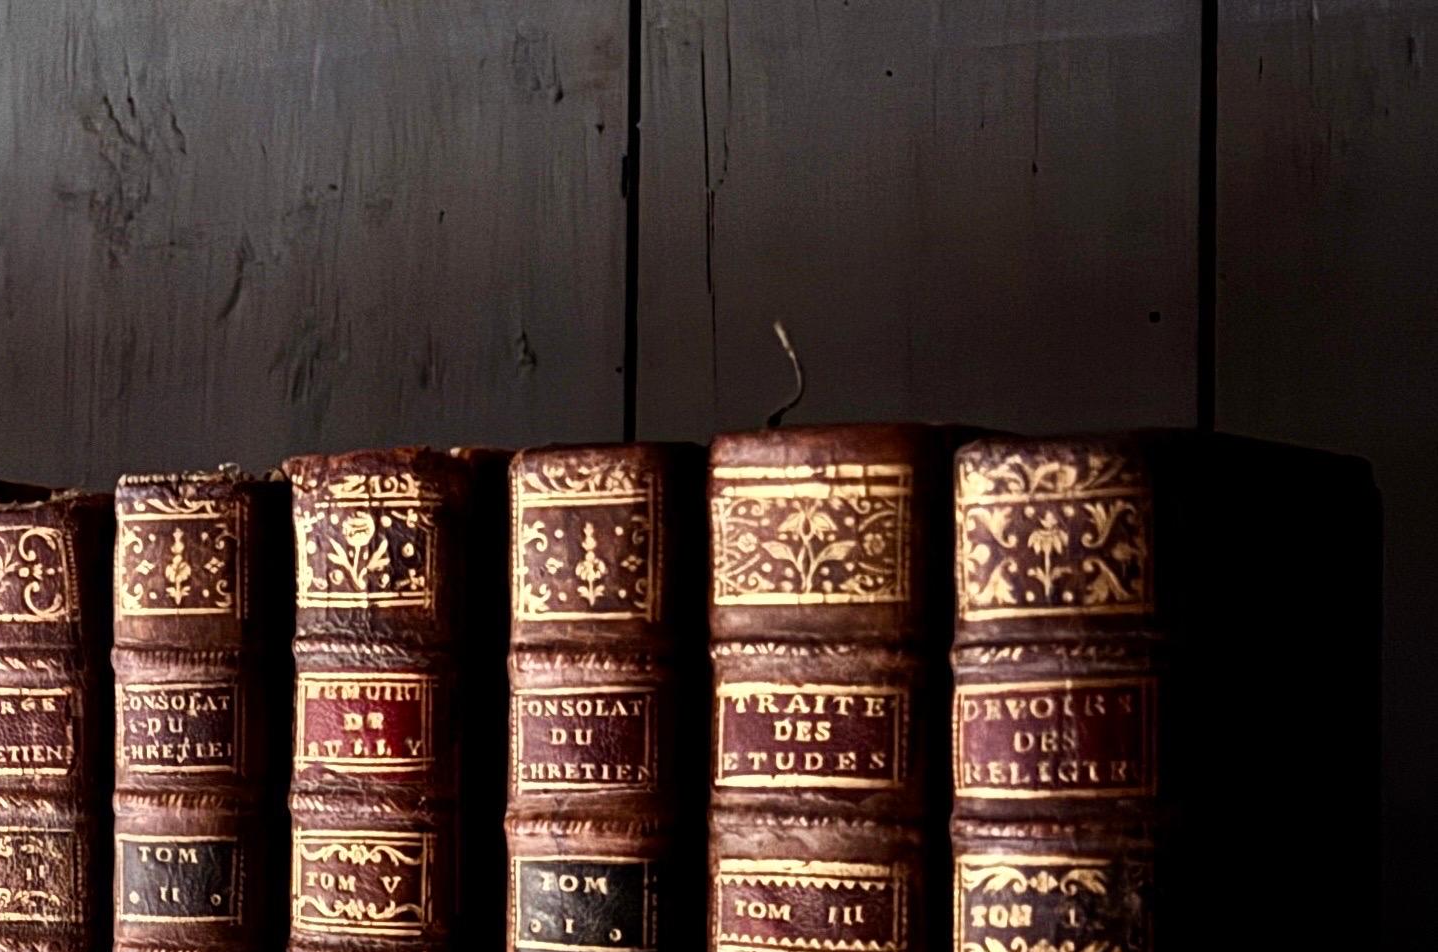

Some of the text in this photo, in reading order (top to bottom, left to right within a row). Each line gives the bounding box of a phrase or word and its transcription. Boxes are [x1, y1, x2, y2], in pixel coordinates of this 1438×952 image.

[731, 695, 886, 717] TRAITE
[963, 695, 1132, 722] DEVOIRS
[147, 716, 183, 736] DU
[344, 712, 384, 731] DE
[774, 719, 832, 742] DES
[550, 729, 593, 745] DU
[1014, 730, 1079, 753] DES
[307, 739, 421, 757] SULLY
[519, 763, 651, 780] CHRETIEN
[723, 752, 886, 771] ETUDES
[963, 760, 1138, 784] RELIGIE
[139, 846, 199, 864] TOM
[26, 865, 46, 881] II
[306, 872, 401, 893] TOM V
[540, 873, 608, 894] TOM
[161, 887, 180, 902] II
[734, 900, 865, 924] TOM III
[969, 904, 1033, 928] TOM
